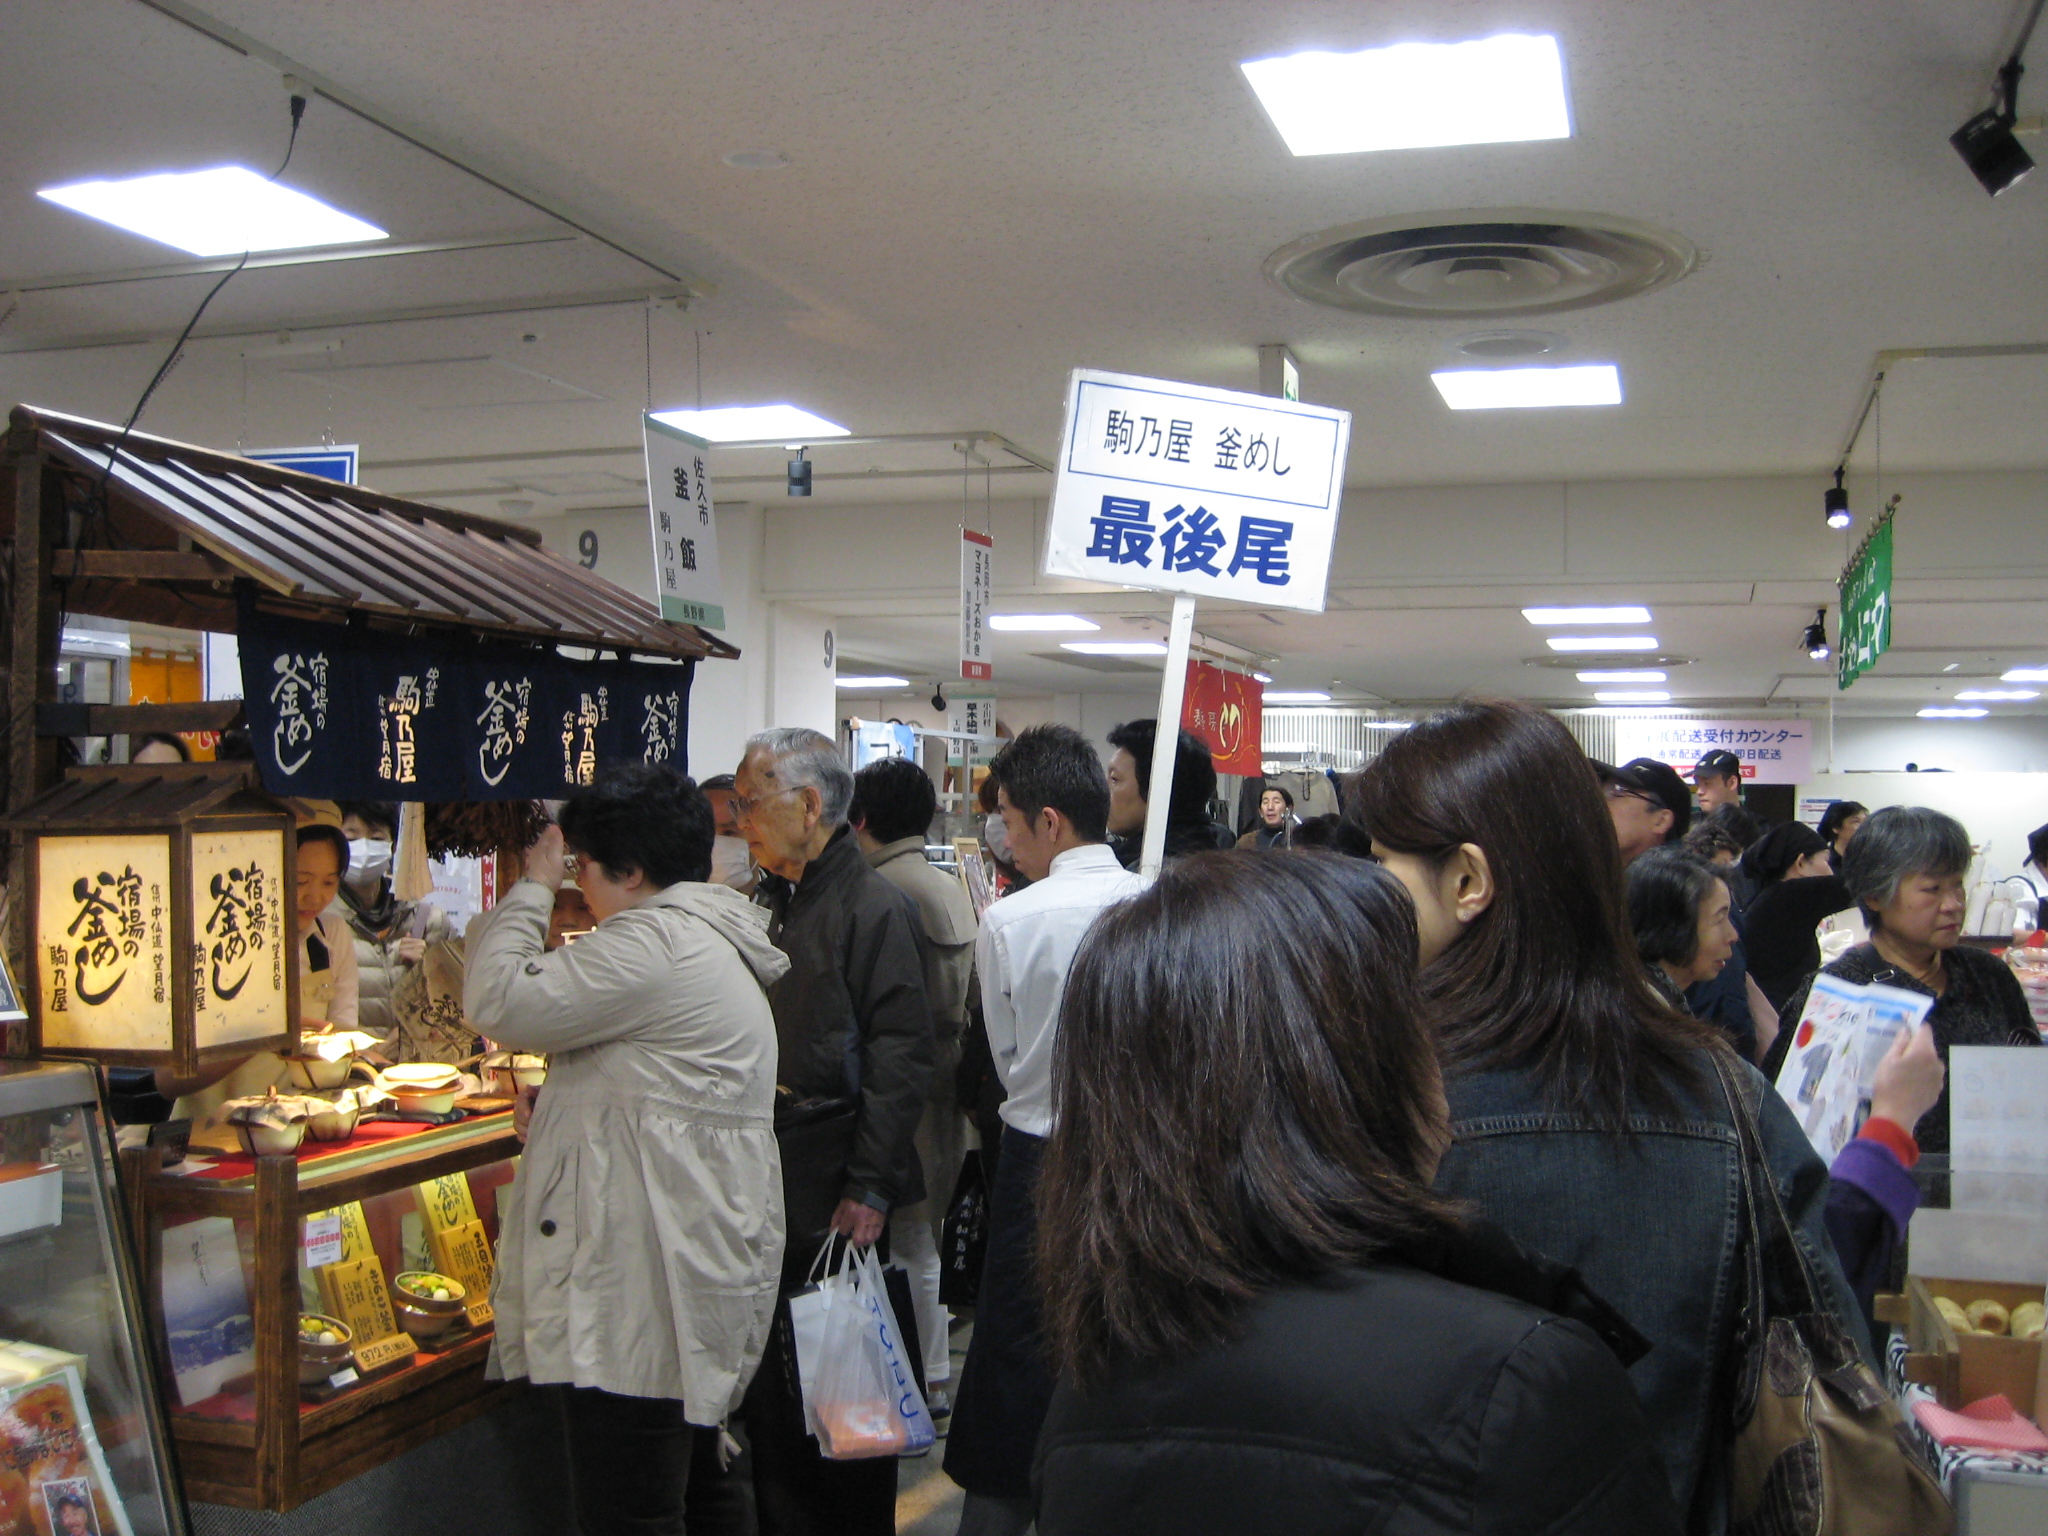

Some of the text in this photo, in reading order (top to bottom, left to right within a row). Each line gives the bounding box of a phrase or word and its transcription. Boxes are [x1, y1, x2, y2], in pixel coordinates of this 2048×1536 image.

[1103, 409, 1291, 476] 駒乃屋 釜めし
[673, 466, 697, 572] 釜飯
[693, 456, 709, 526] 佐久市
[579, 529, 598, 570] 9
[659, 510, 678, 590] 駒乃屋
[1086, 494, 1295, 587] 最後尾
[973, 549, 982, 656] マヨネーズおかき
[823, 629, 834, 669] 9
[271, 654, 313, 775] 釜めし
[309, 652, 329, 729] 宿場の
[515, 677, 532, 745] 宿場の
[389, 676, 421, 784] 駒乃屋
[477, 680, 516, 786] 釜めし
[67, 871, 128, 1005] 釜めし
[116, 864, 147, 959] 宿場の
[150, 905, 163, 949] 中仙道
[206, 867, 253, 1002] 釜めし
[245, 861, 267, 951] 宿場の
[269, 896, 280, 938] 中仙道
[50, 945, 68, 1012] 駒乃屋
[152, 953, 165, 1004] 望月宿
[271, 942, 281, 991] 望月宿
[361, 1347, 383, 1362] 972
